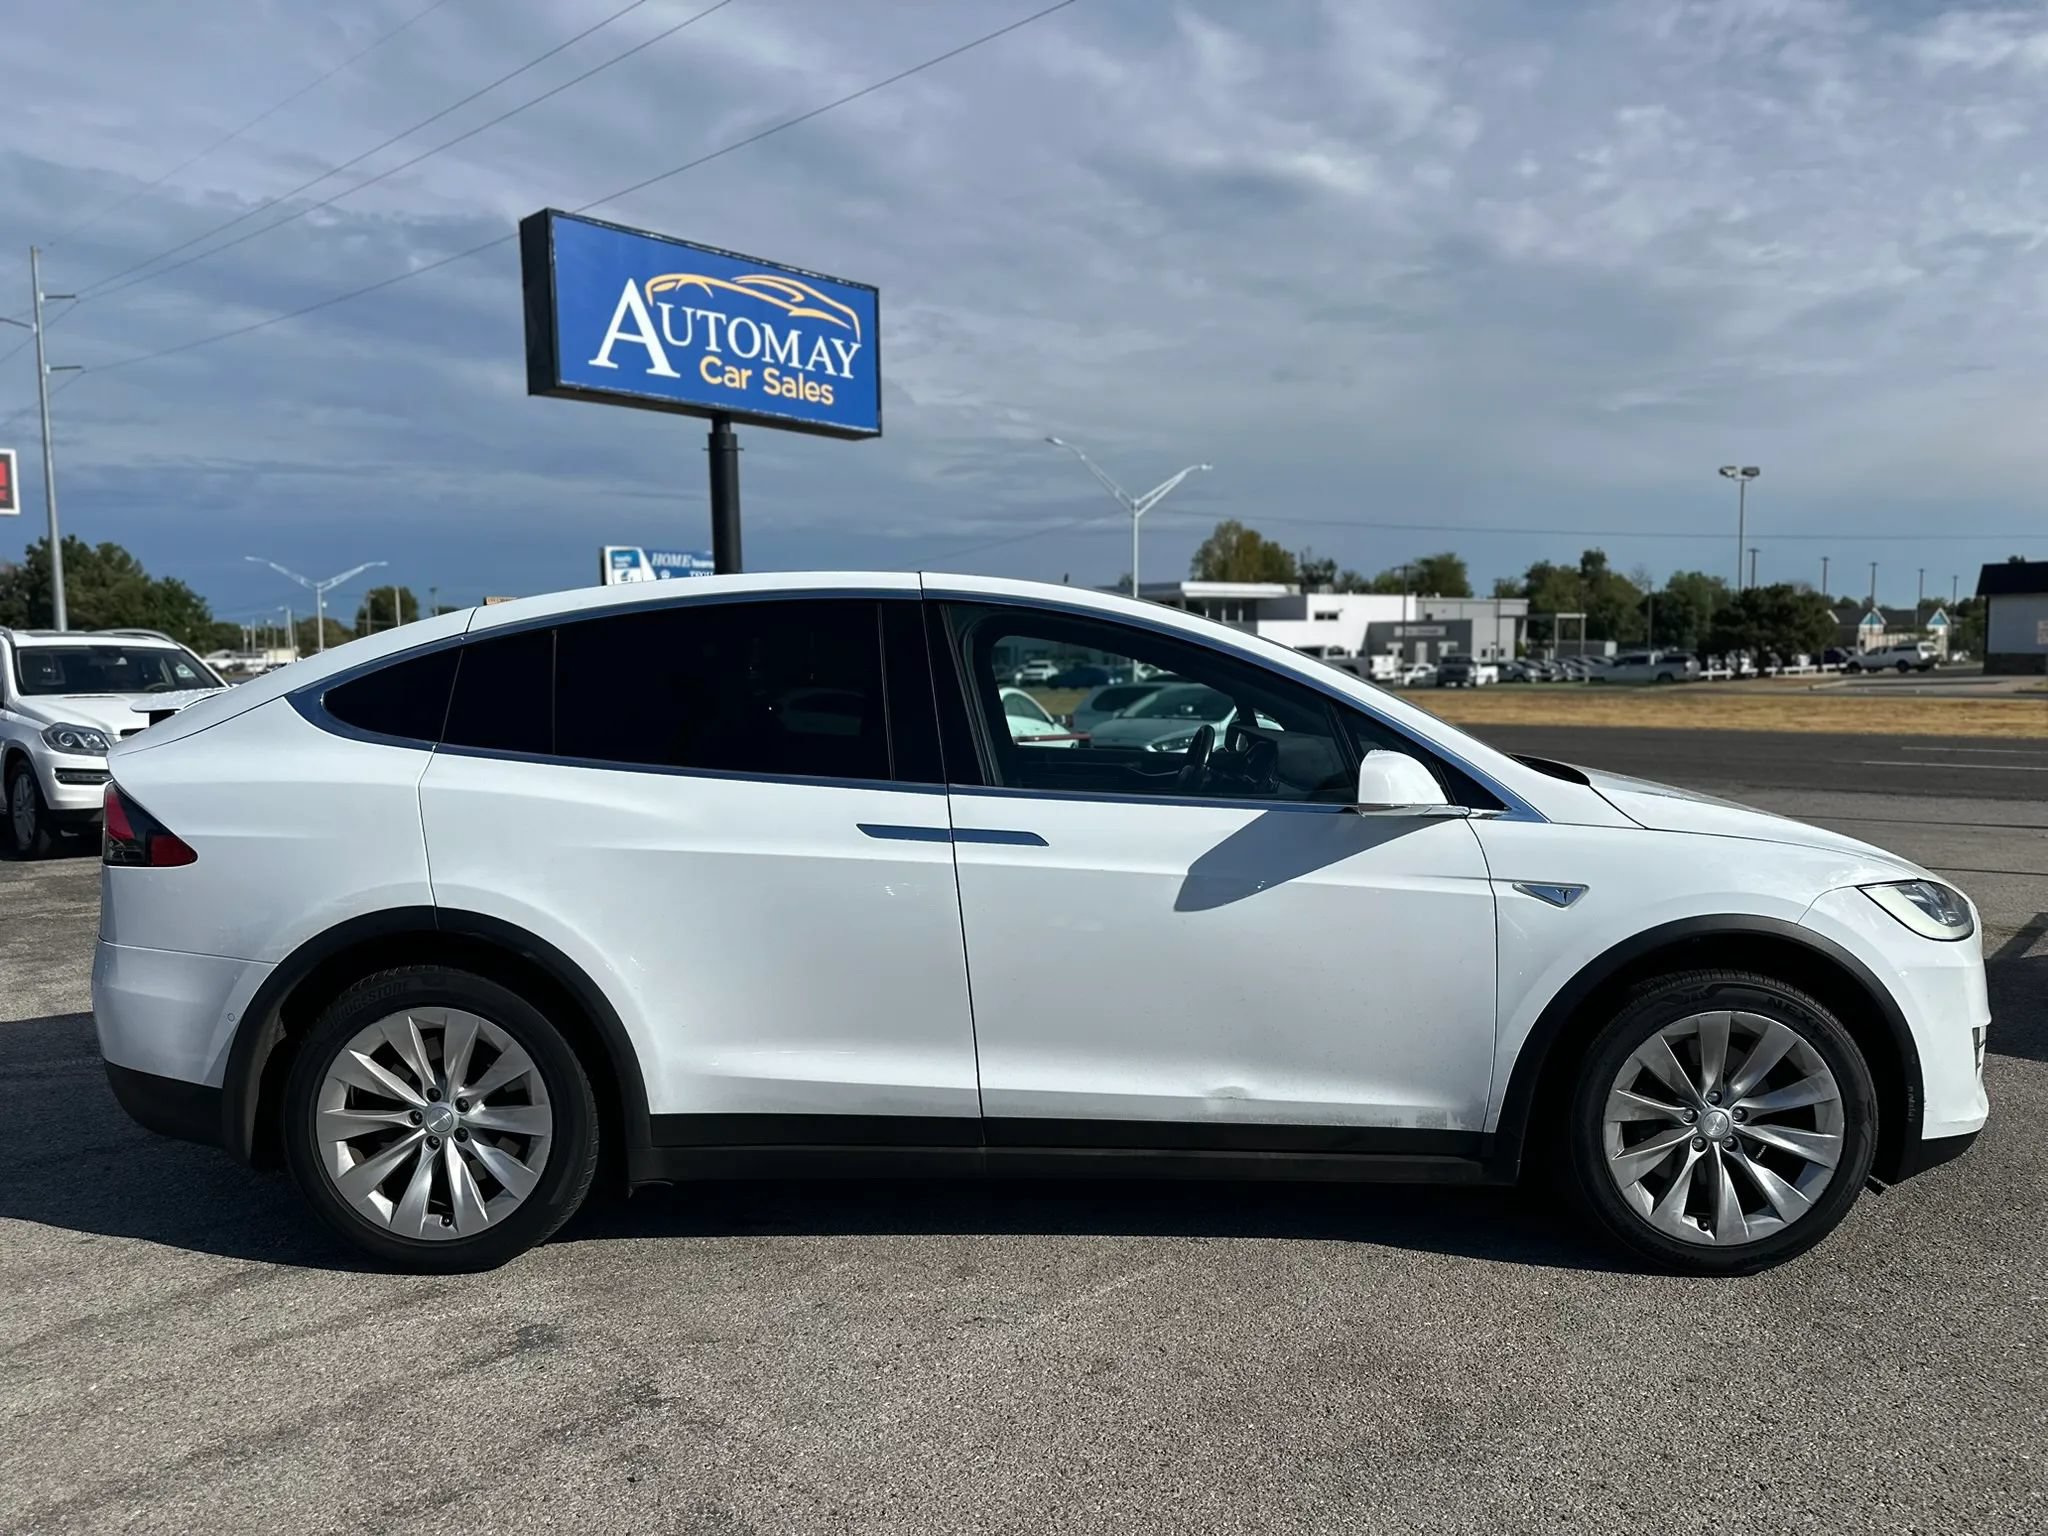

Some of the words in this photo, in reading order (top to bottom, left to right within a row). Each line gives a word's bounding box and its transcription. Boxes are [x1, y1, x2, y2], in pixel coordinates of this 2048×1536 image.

[588, 278, 861, 379] AUTOMAY
[700, 355, 752, 390] Car
[763, 367, 835, 406] Sales
[651, 551, 692, 568] HOME
